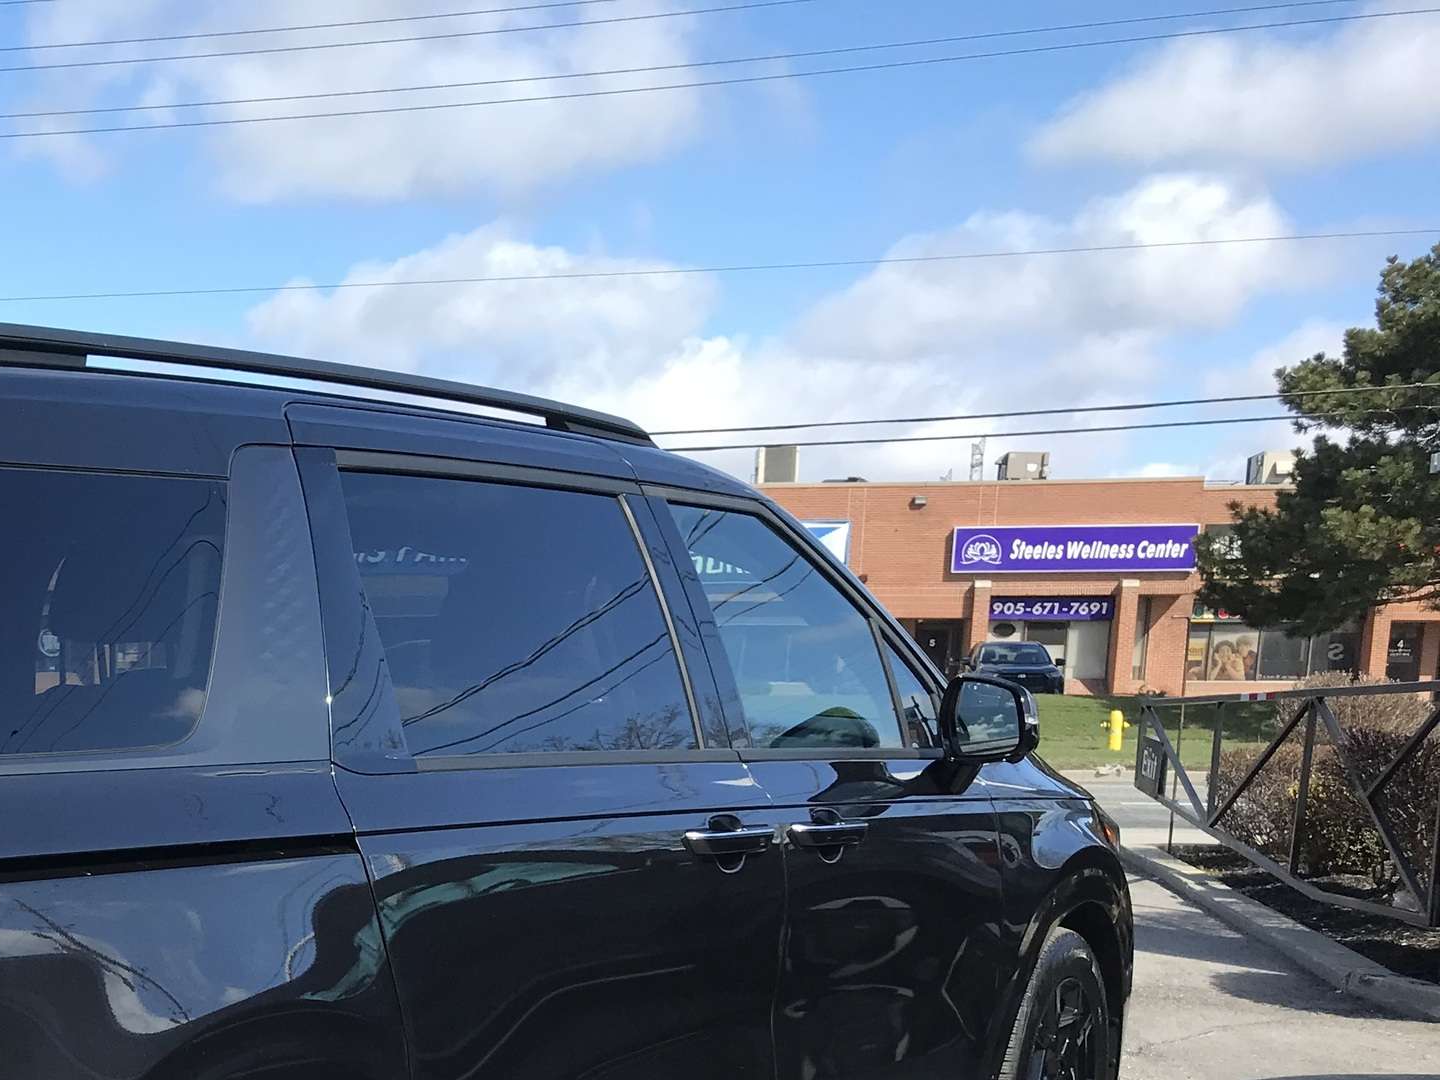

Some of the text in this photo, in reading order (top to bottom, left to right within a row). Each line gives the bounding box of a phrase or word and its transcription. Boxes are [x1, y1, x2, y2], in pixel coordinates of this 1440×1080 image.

[1010, 538, 1189, 560] Steeles Wellness Center
[992, 601, 1109, 616] 905-671-7691
[1142, 749, 1158, 780] Exit
